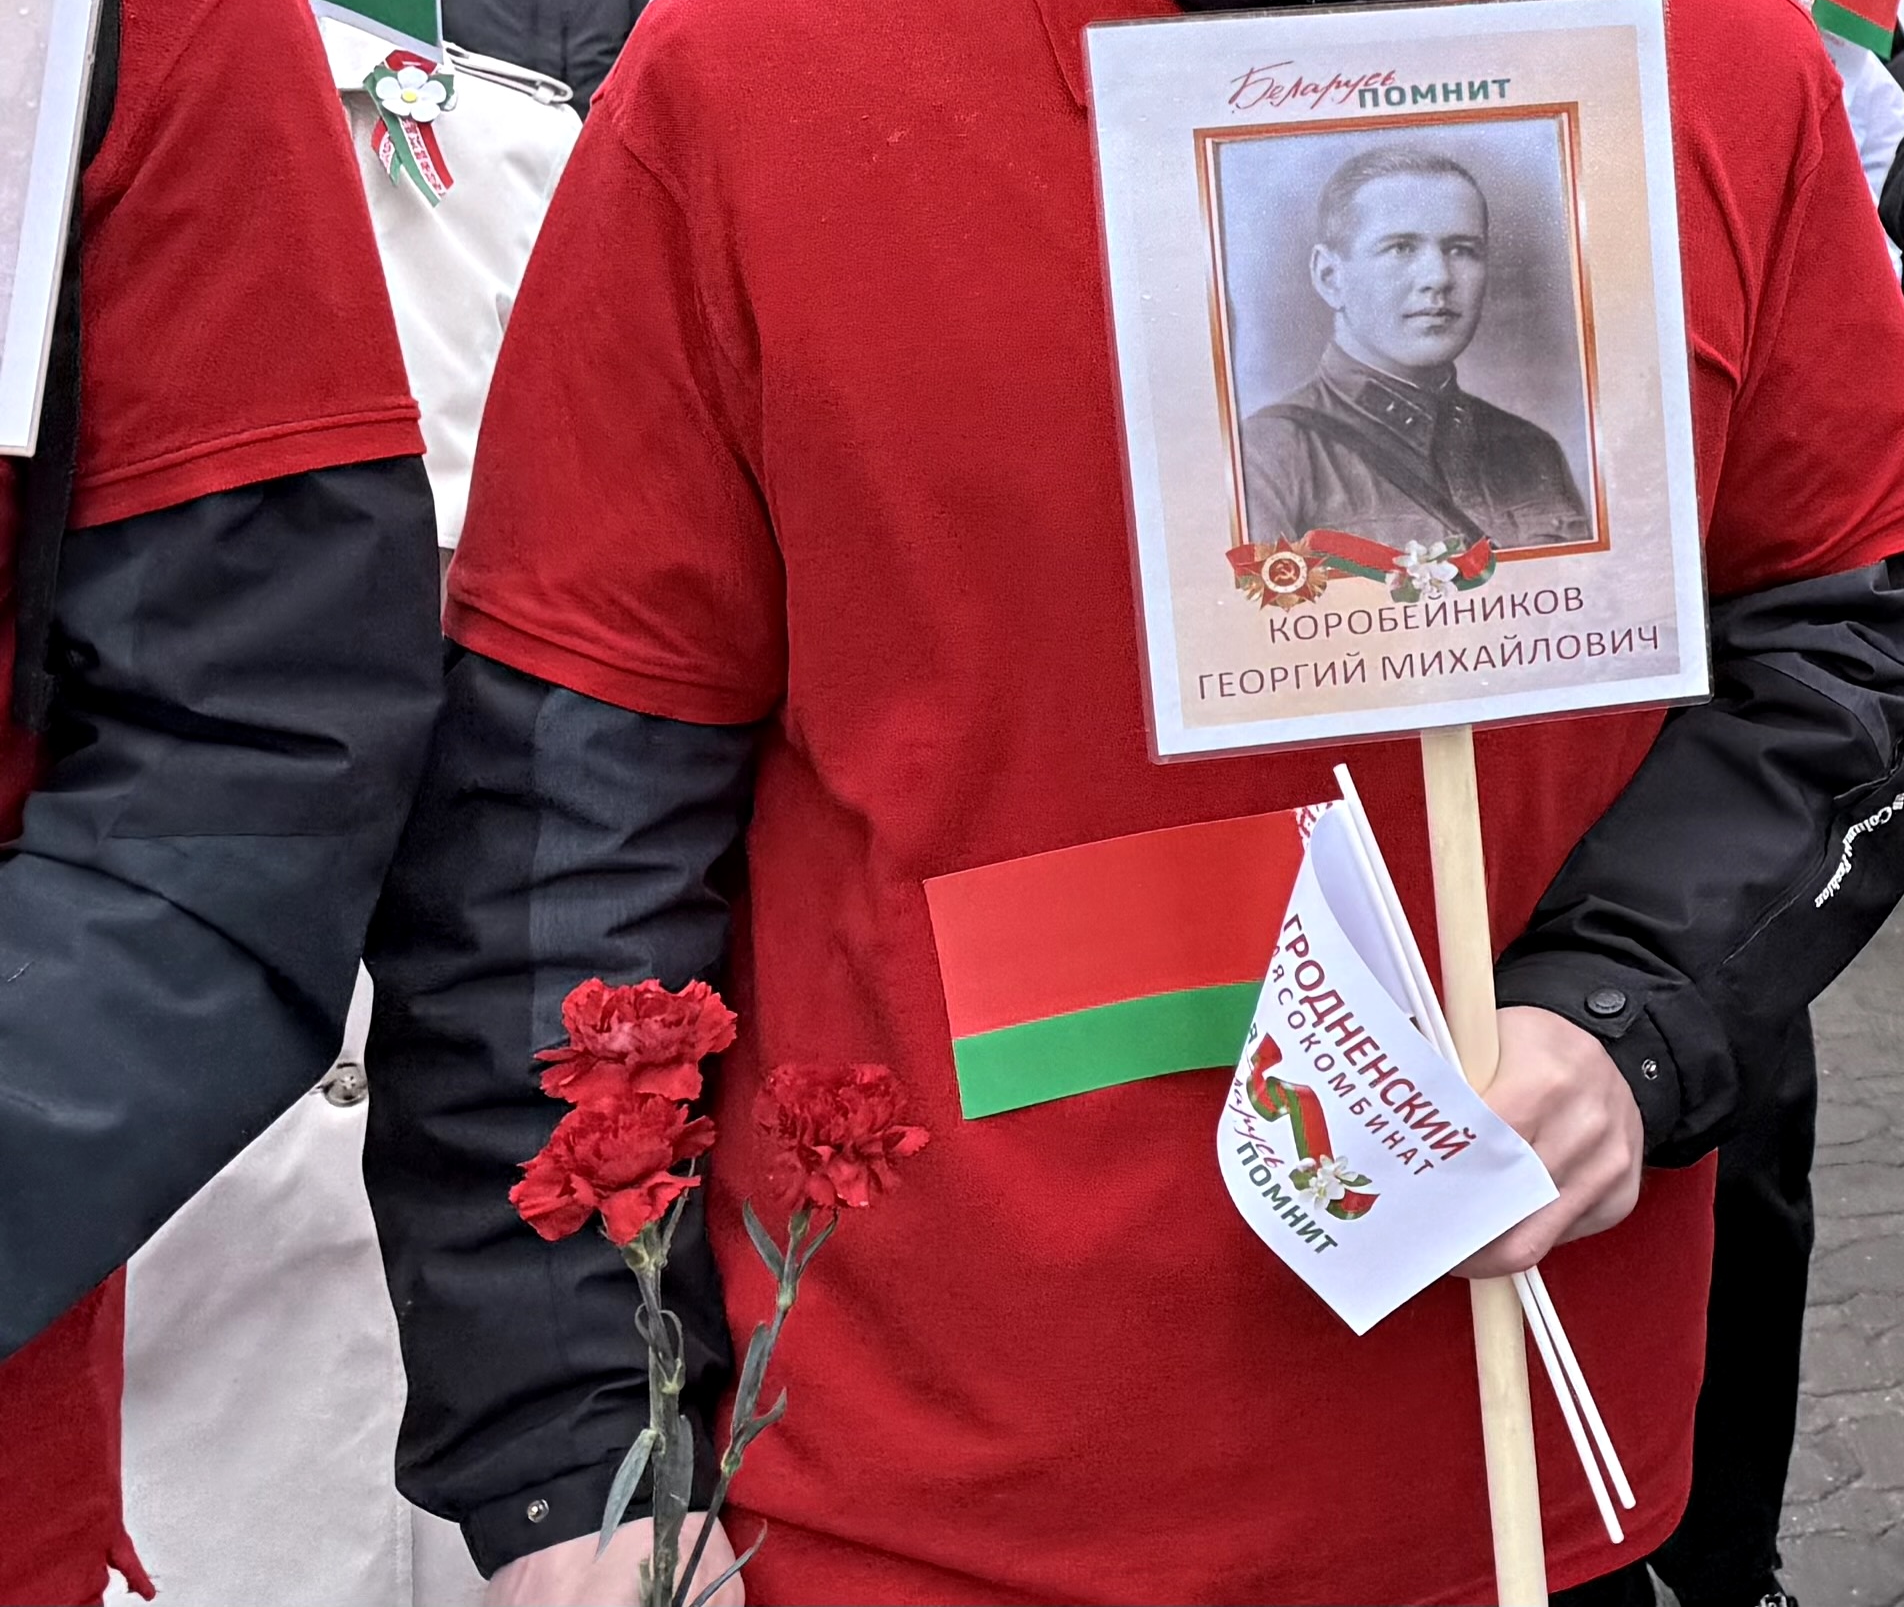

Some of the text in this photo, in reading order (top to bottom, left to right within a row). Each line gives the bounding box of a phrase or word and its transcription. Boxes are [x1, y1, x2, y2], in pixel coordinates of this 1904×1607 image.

[1227, 59, 1397, 111] Беларусь
[1357, 77, 1512, 110] ПОМНИТ
[1268, 585, 1586, 646] КОРОБЕЙНИКОВ
[1197, 623, 1661, 702] ГЕОРГИЙ МИХАЙЛОВИЧ
[1282, 912, 1478, 1162] ГРОДНЕНСКИЙ
[1235, 1140, 1339, 1255] ПОМНИТ
